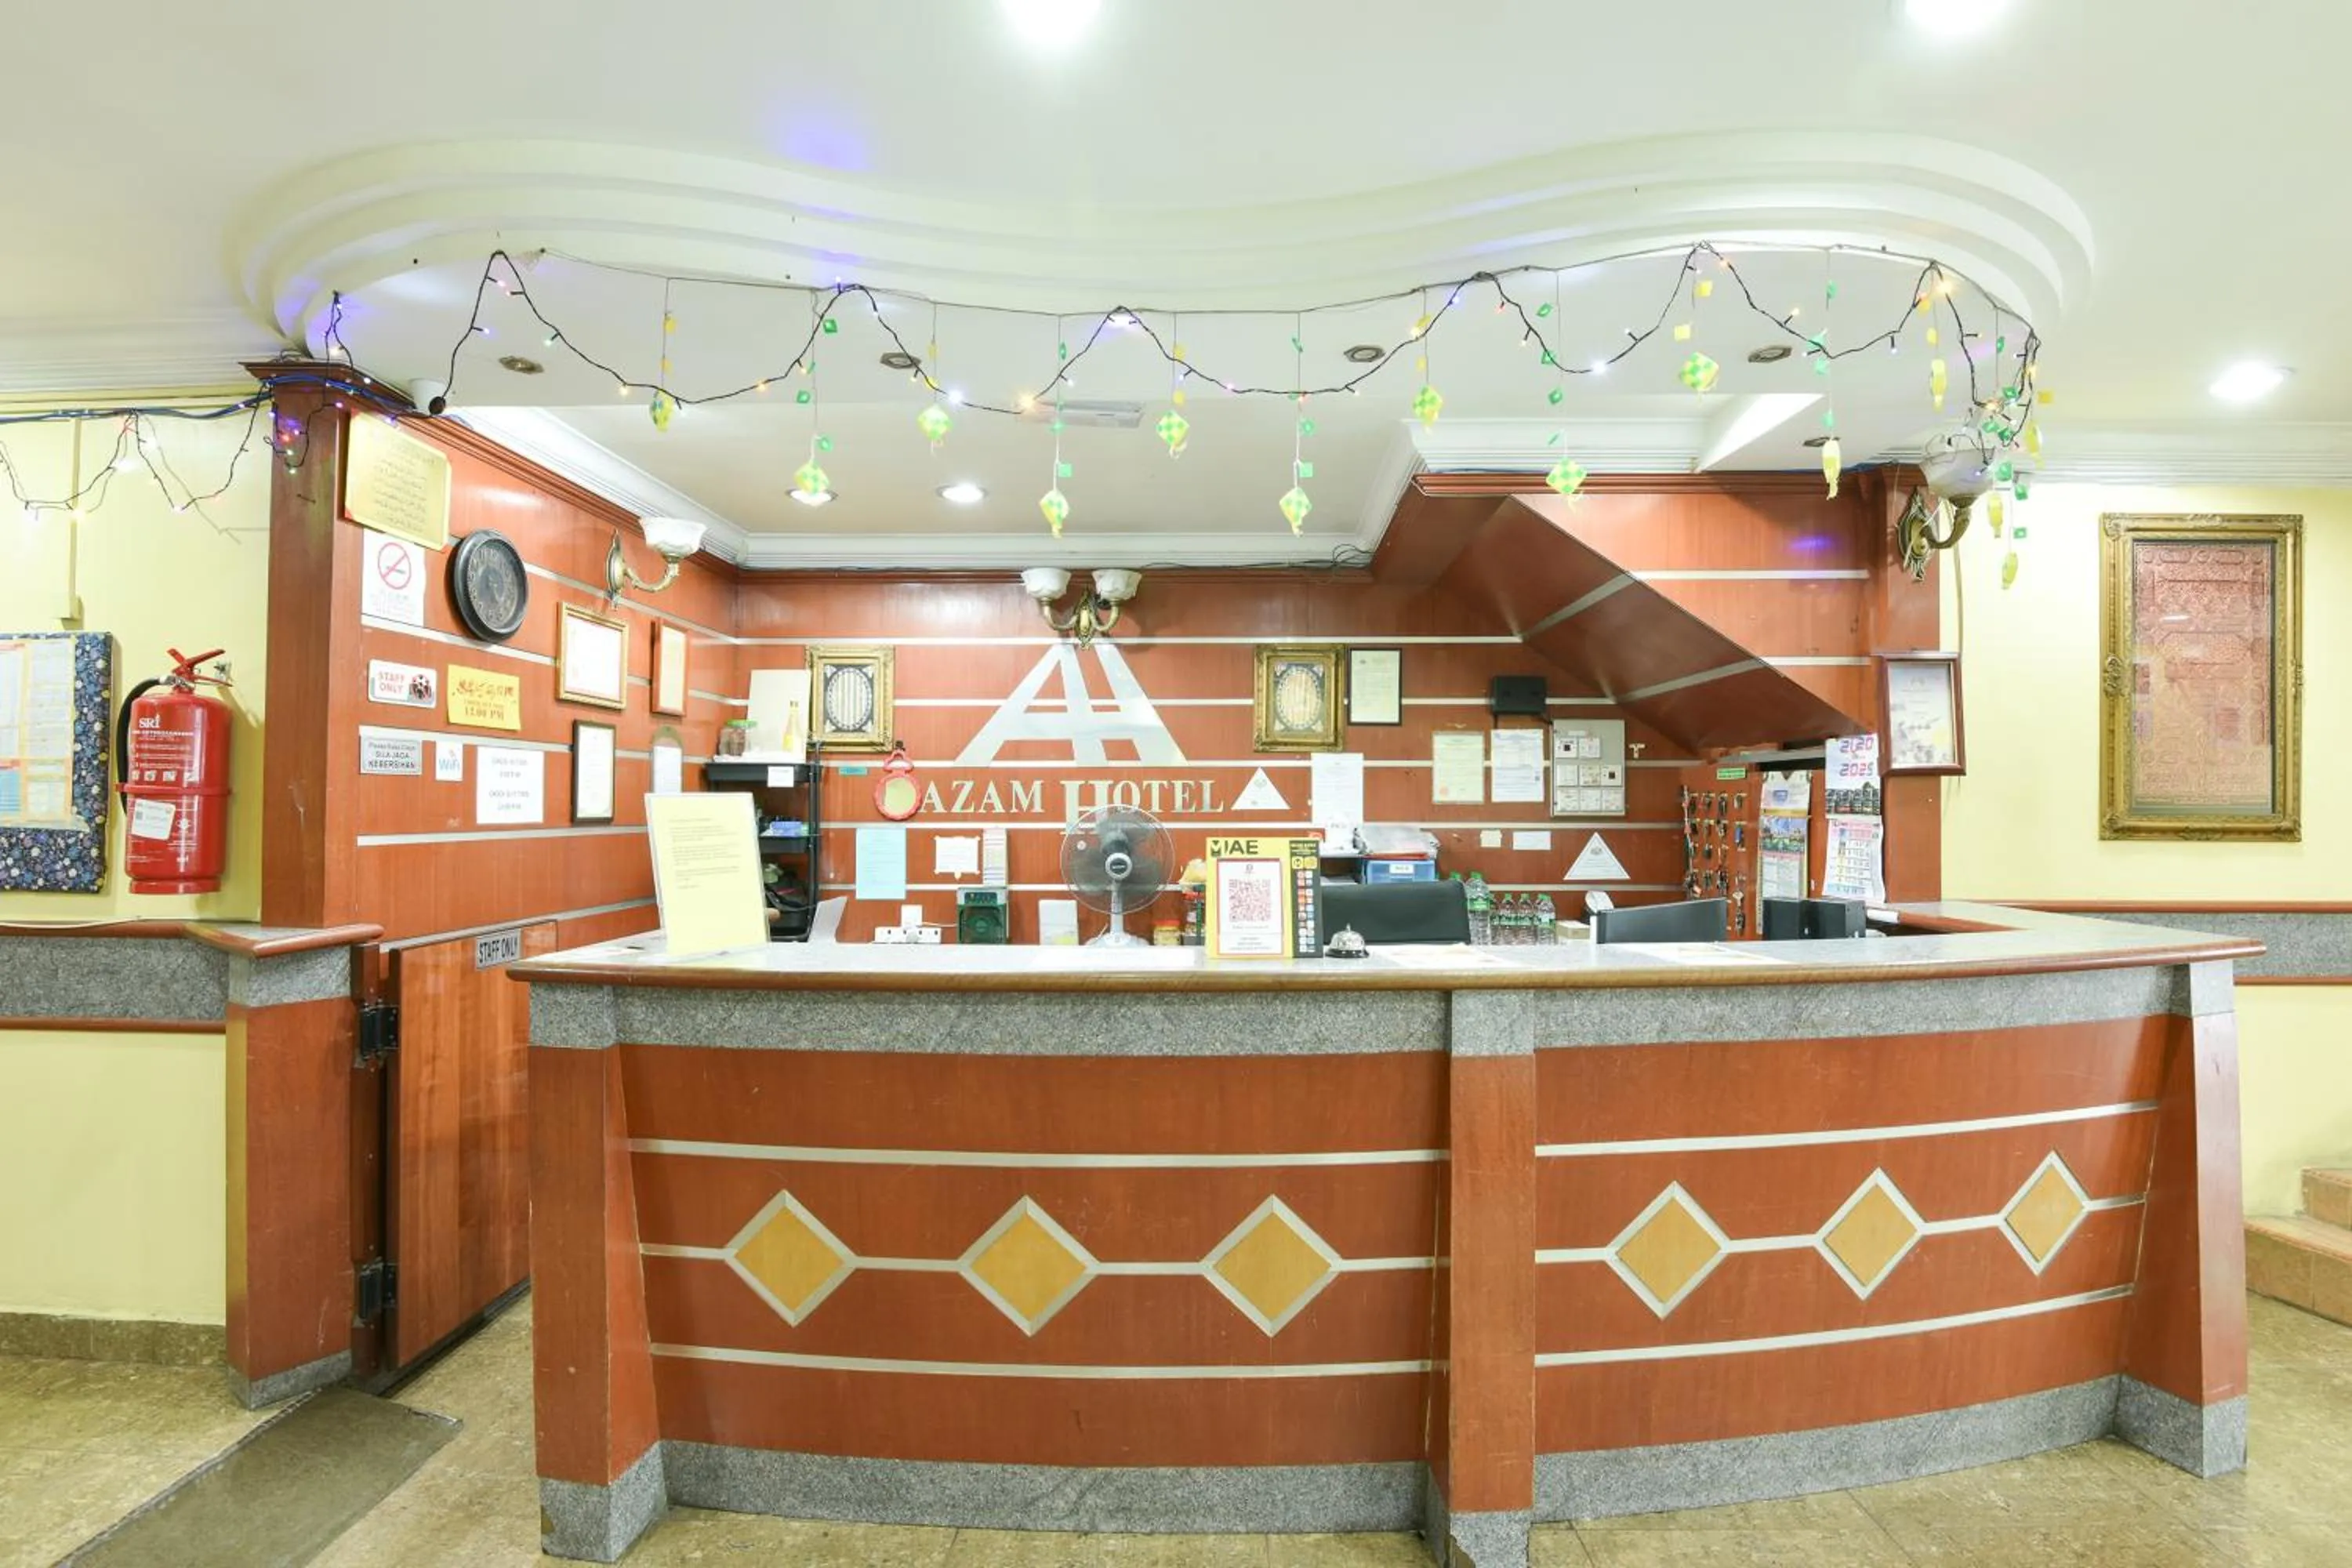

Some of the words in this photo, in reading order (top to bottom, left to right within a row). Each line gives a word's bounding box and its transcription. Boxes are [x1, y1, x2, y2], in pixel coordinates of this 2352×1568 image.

[378, 671, 405, 684] STAFF
[379, 682, 404, 694] ONLY
[917, 779, 1046, 814] AZAM
[1059, 779, 1224, 835] HOTEL
[479, 939, 500, 964] STAFF
[502, 936, 518, 958] ONLY
